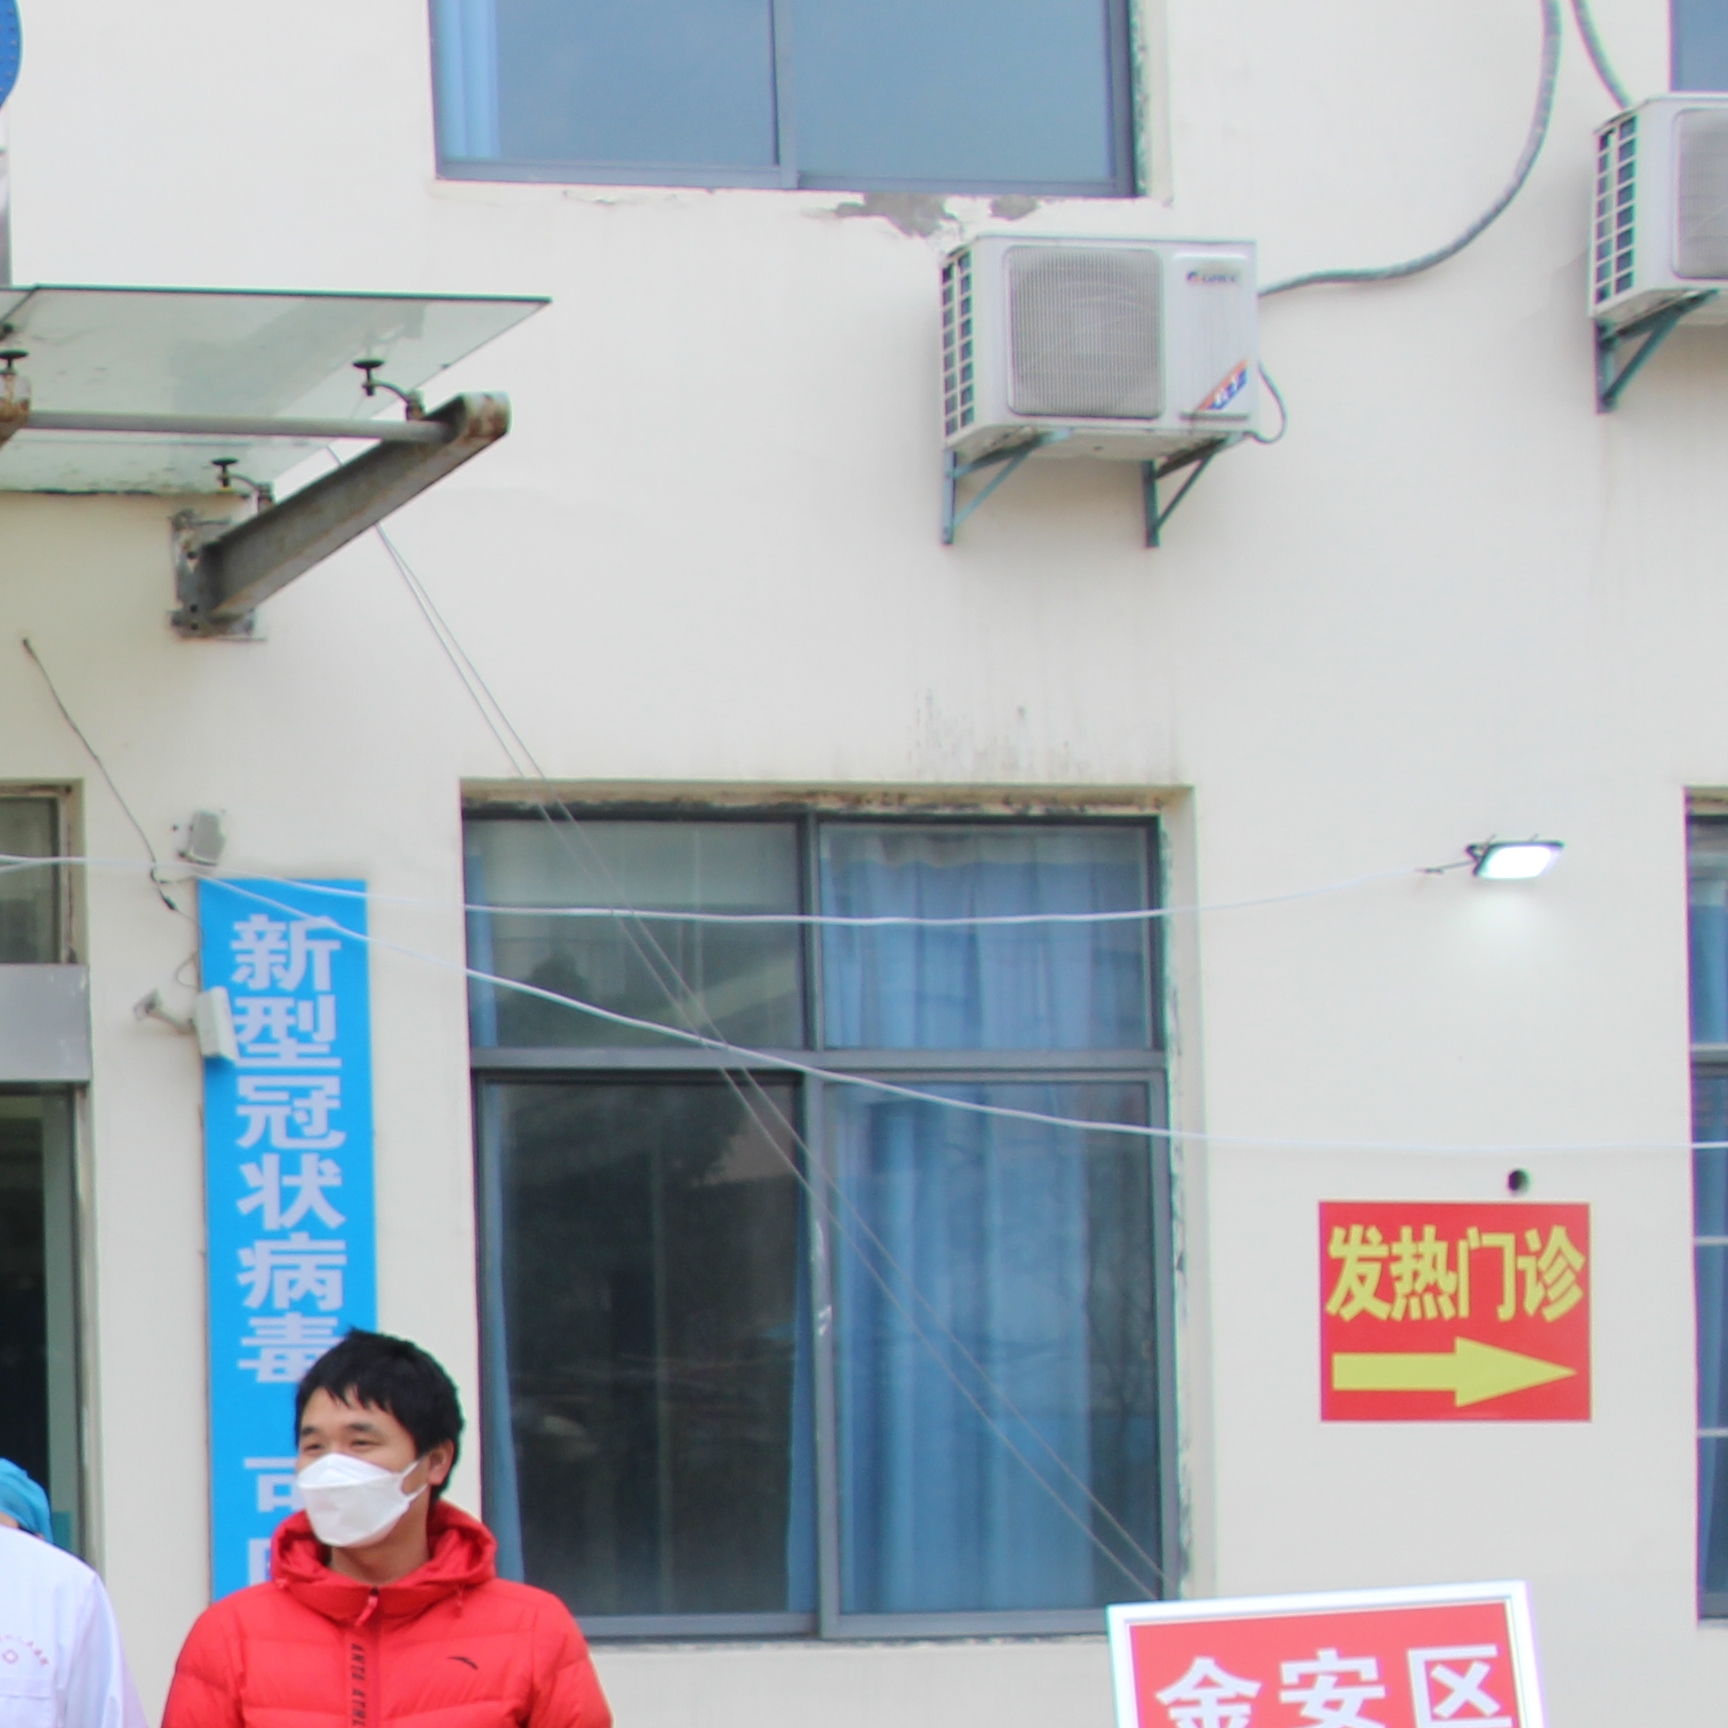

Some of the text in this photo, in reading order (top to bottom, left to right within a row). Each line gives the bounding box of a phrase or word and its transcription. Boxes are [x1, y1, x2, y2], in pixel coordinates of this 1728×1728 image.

[229, 912, 348, 1384] 新型冠状病毒
[1325, 1224, 1586, 1322] 发热门诊
